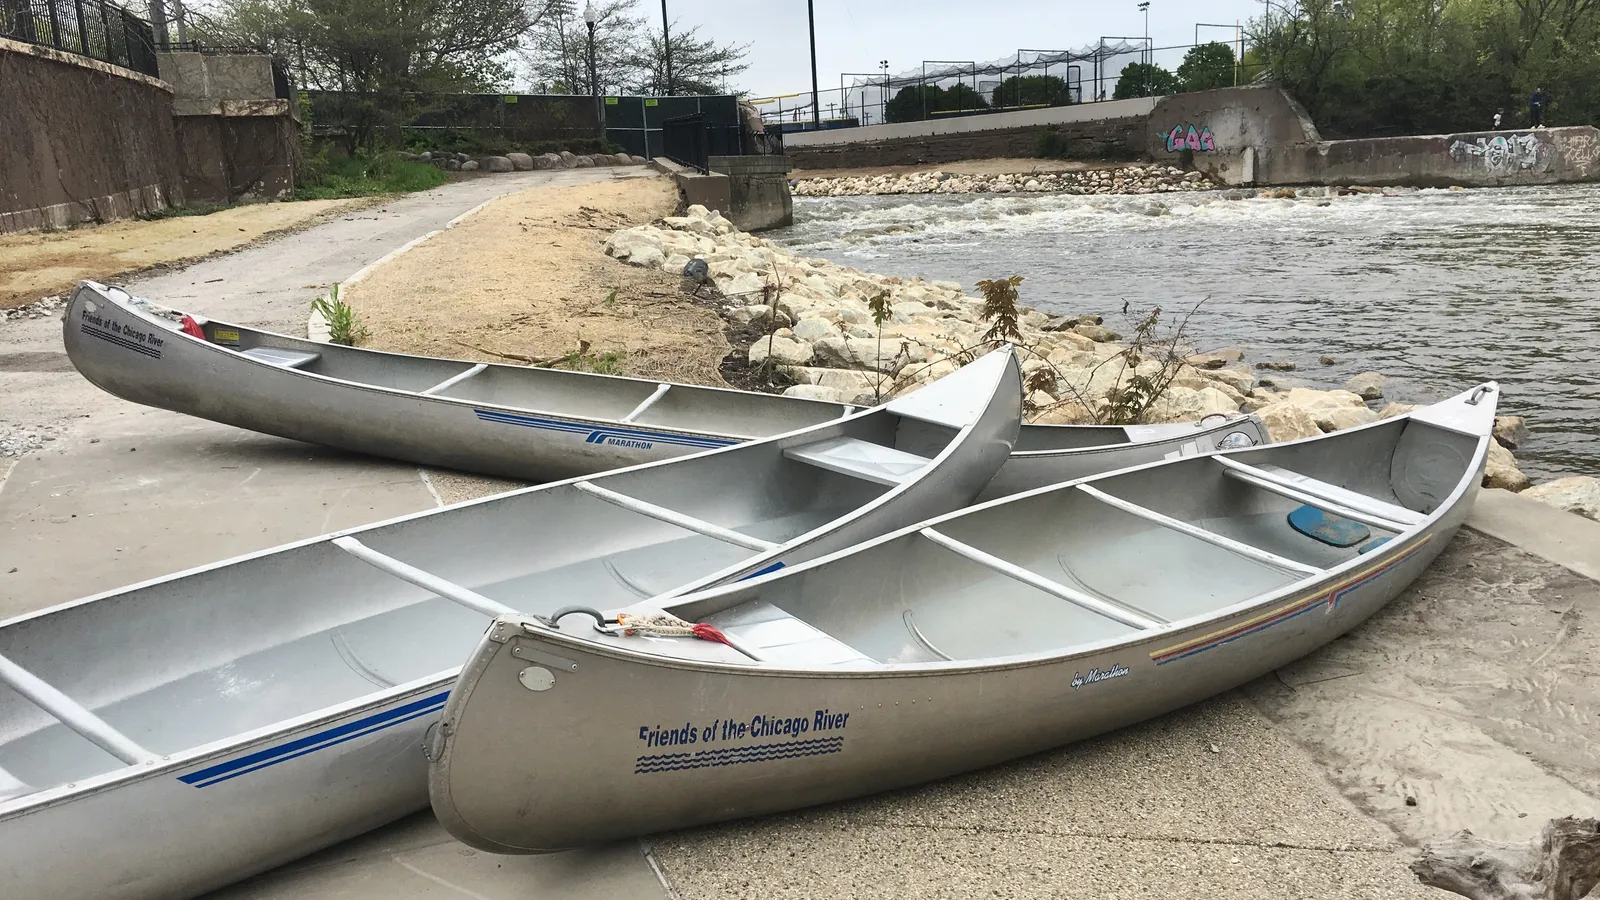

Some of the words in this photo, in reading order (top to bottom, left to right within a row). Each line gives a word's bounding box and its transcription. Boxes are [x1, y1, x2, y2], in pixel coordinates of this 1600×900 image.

[82, 310, 102, 326] Friends
[104, 319, 111, 329] of
[112, 321, 122, 333] the
[123, 324, 147, 343] Chicago
[148, 333, 164, 347] River
[607, 438, 653, 450] MARATHON
[1071, 671, 1083, 691] by
[1084, 663, 1130, 684] Marathon
[639, 722, 698, 748] Friends
[702, 719, 719, 743] of
[722, 718, 746, 740] the
[750, 715, 809, 738] Chicago
[812, 709, 850, 731] River
